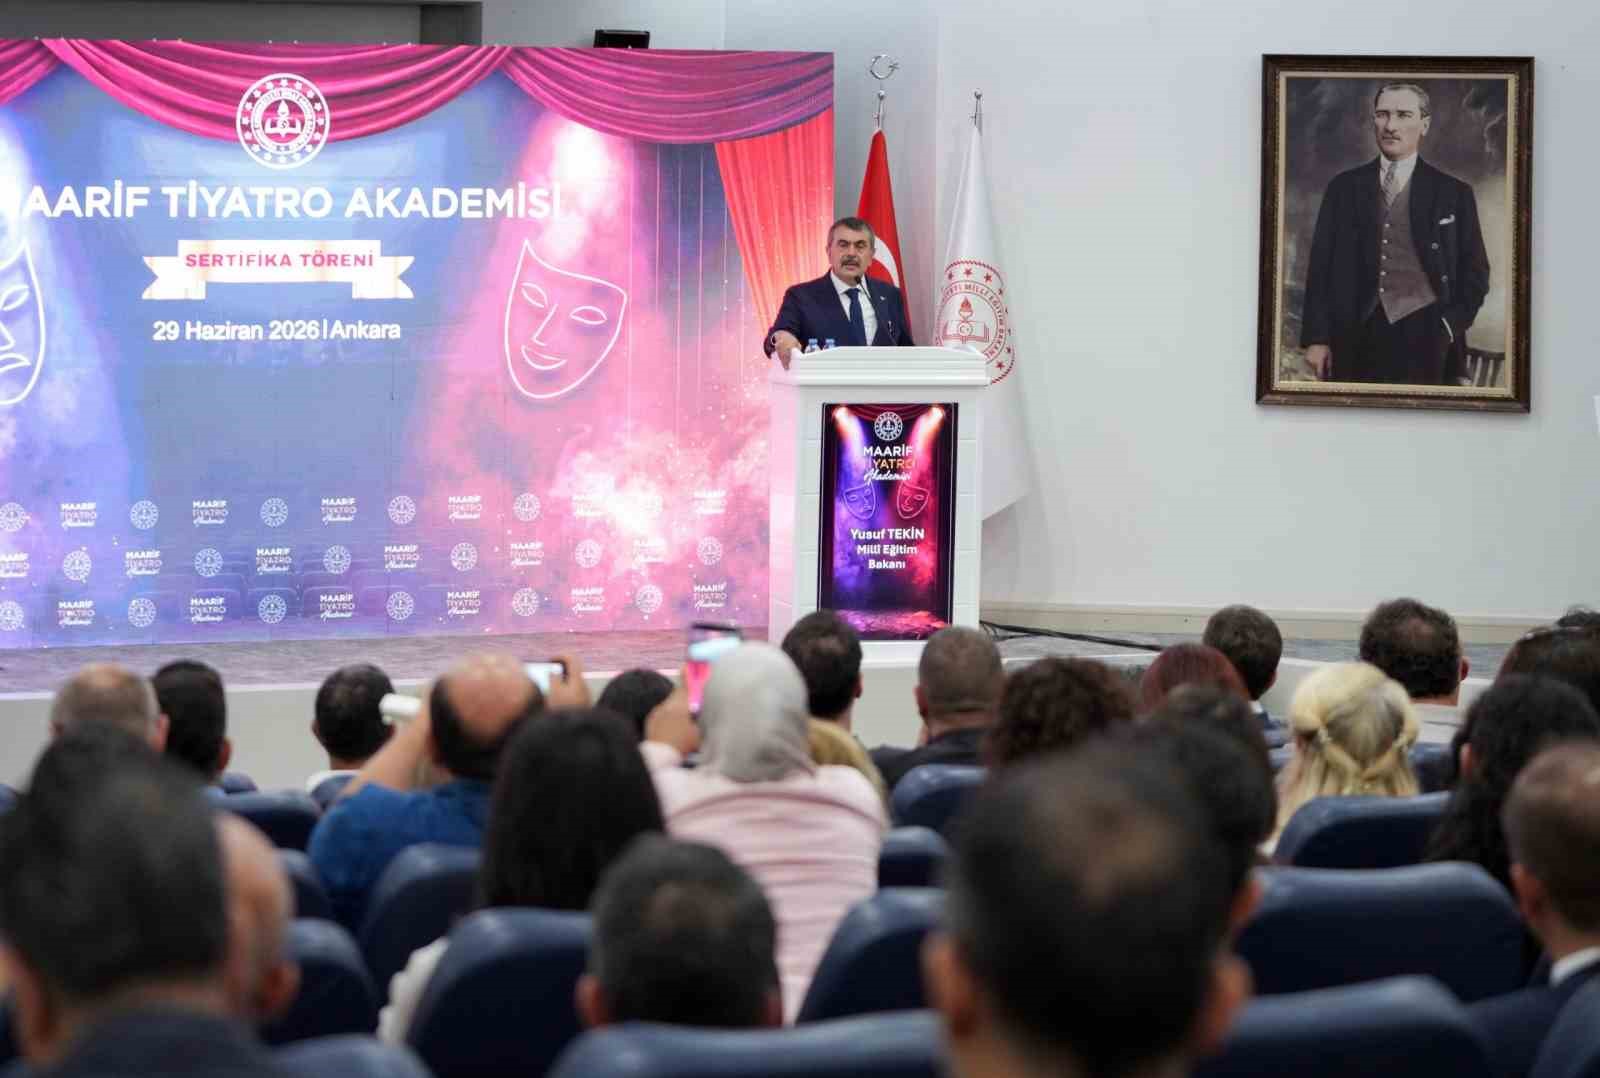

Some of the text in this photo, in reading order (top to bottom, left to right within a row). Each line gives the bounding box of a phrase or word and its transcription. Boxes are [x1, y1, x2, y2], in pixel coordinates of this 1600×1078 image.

[21, 179, 562, 219] AARİF TİYATRO AKADEMİSİ
[185, 250, 373, 267] SERTİFİKA TÖRENİ
[152, 320, 180, 341] 29
[185, 320, 264, 341] Haziran
[269, 319, 321, 341] 2026
[329, 319, 401, 340] Ankara
[863, 443, 913, 457] MAARİF
[850, 526, 925, 540] Yusuf TEKİN
[883, 543, 918, 557] Eğitim
[868, 559, 906, 569] Bakanı
